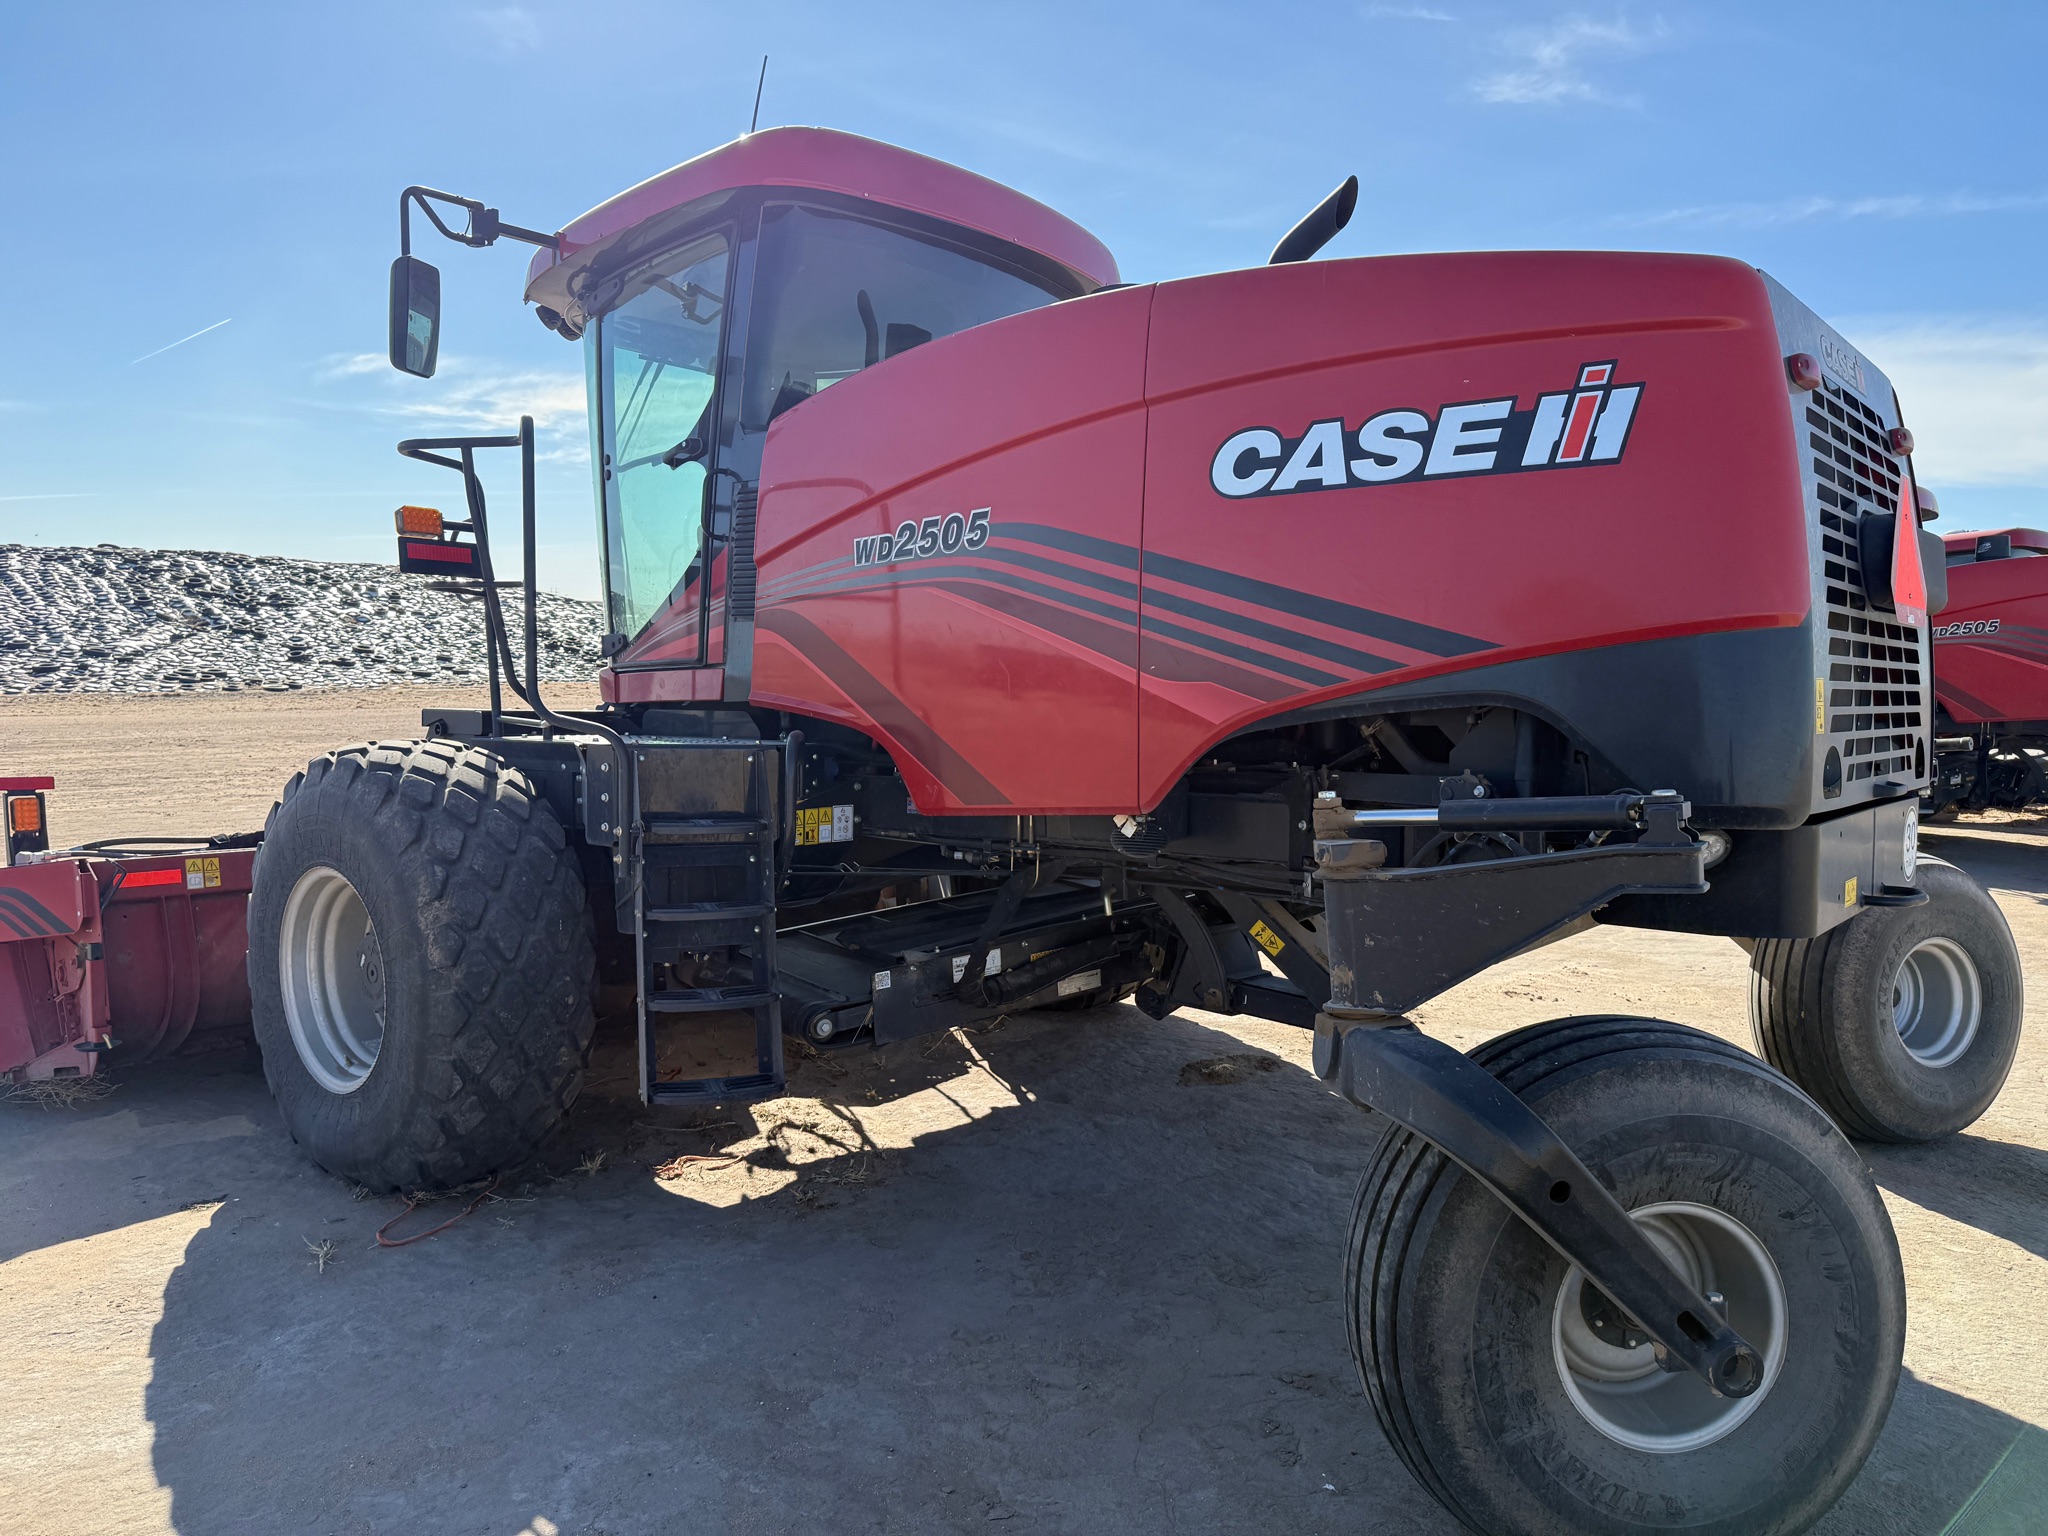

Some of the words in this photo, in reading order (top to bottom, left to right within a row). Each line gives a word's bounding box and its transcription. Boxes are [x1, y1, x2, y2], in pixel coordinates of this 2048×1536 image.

[1210, 399, 1514, 497] CASE
[1520, 362, 1641, 467] IH
[853, 506, 992, 567] WD2505
[1905, 821, 1916, 853] 30
